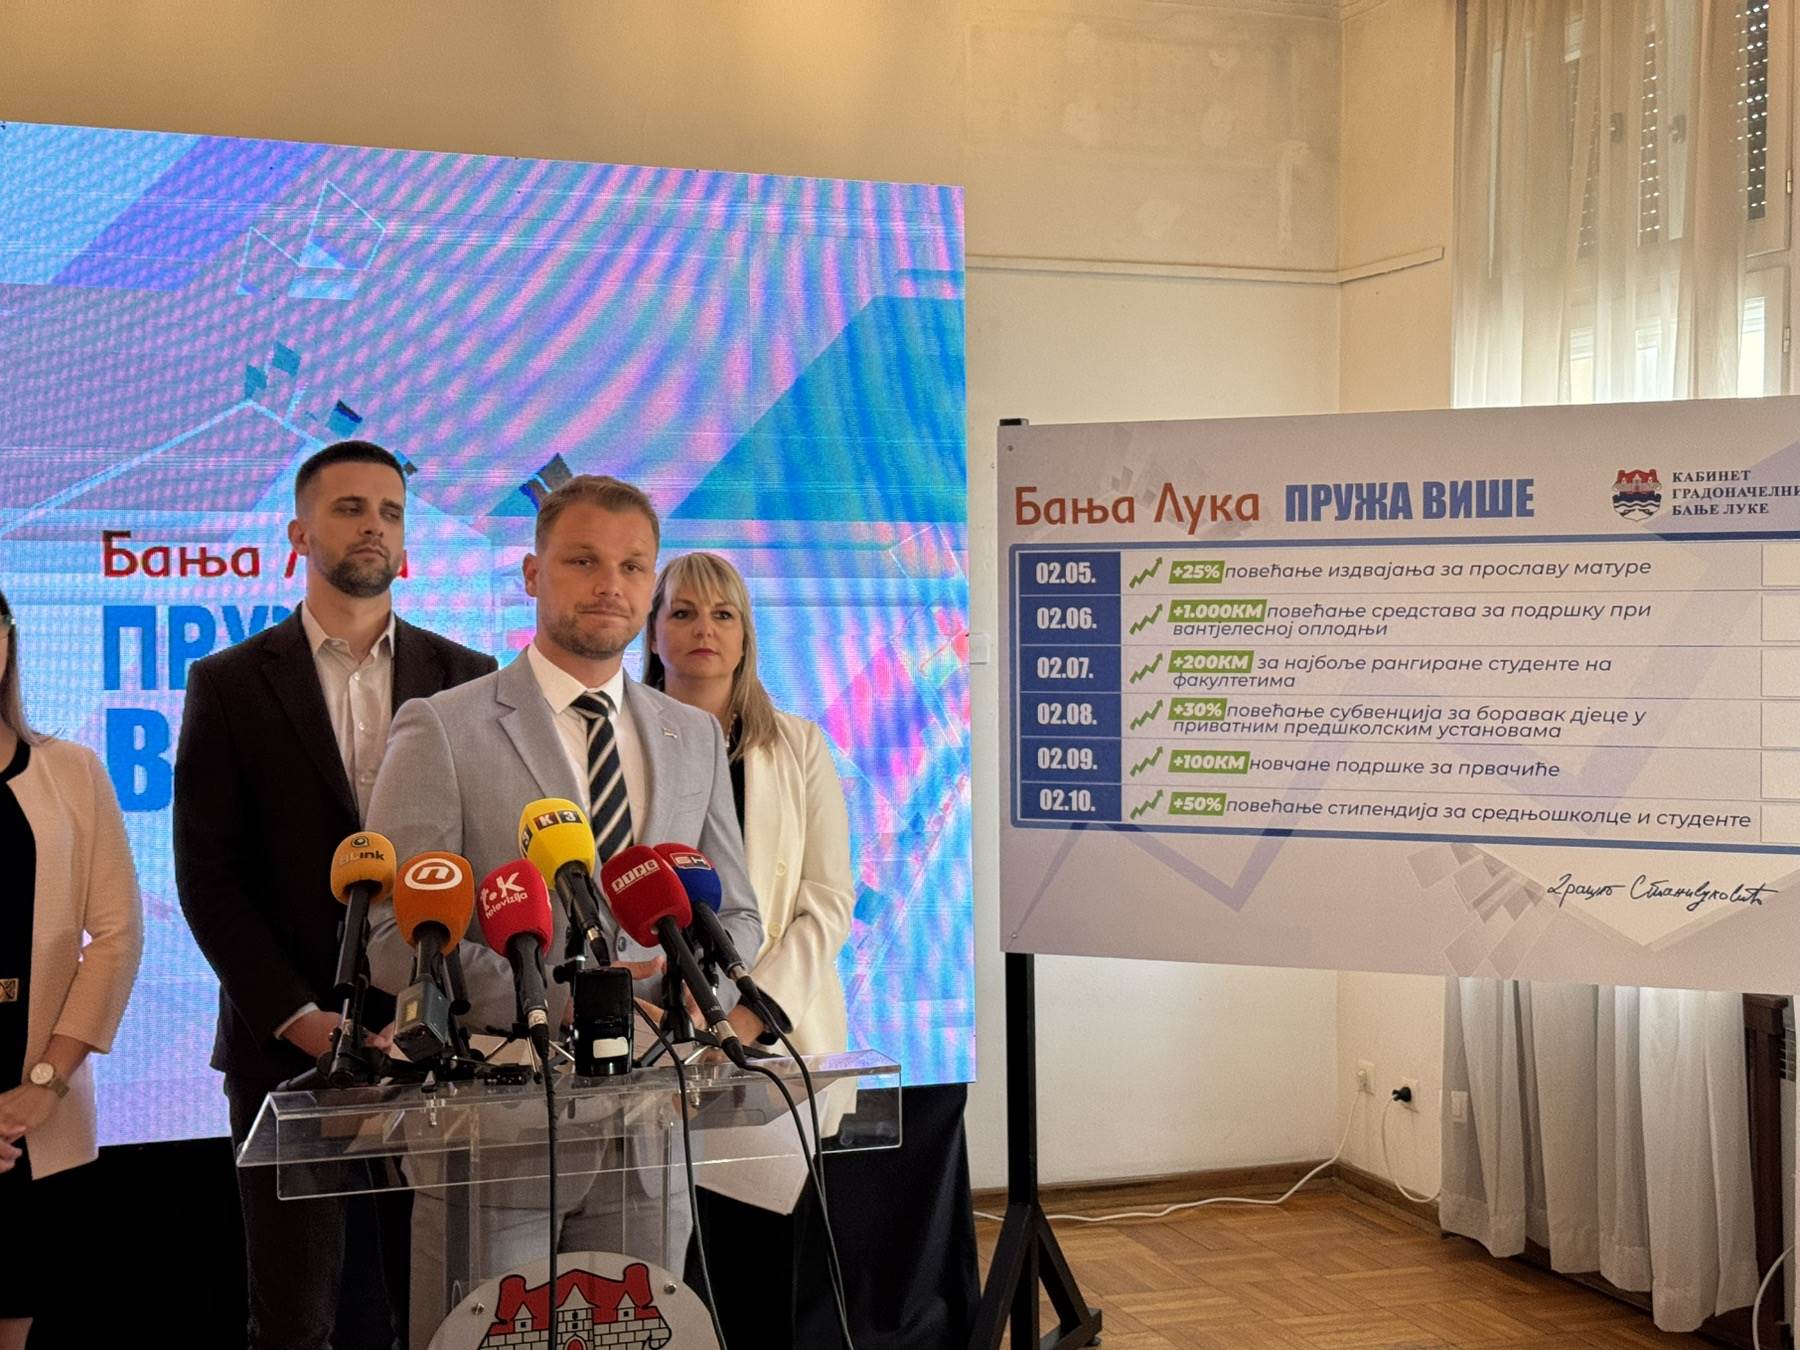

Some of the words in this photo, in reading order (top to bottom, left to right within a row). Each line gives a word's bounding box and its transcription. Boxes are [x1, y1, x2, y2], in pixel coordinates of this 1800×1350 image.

[1672, 470, 1751, 482] КАБИНЕТ
[1015, 486, 1135, 526] Бања
[1154, 482, 1260, 535] Лука
[1285, 481, 1413, 522] ПРУЖА
[1422, 478, 1535, 520] ВИШЕ
[1672, 504, 1719, 516] БАЊЕ
[1723, 503, 1769, 515] ЛУКЕ
[102, 530, 261, 579] Бања
[1035, 561, 1097, 585] 02.05.
[1172, 564, 1220, 579] +25%
[1225, 562, 1322, 579] повећање
[1328, 562, 1435, 582] издвајања
[1440, 564, 1463, 577] за
[1469, 562, 1570, 580] прославу
[1574, 561, 1651, 577] матуре
[1036, 607, 1097, 630] 02.06.
[1173, 604, 1263, 620] +1.000КМ
[1267, 603, 1366, 619] повећање
[1371, 605, 1476, 621] средстава
[1481, 605, 1505, 618] за
[1511, 604, 1605, 620] подршку
[1610, 604, 1651, 619] при
[1173, 622, 1293, 639] вантјелесној
[1298, 622, 1388, 638] оплодњи
[1036, 657, 1094, 679] 02.07.
[1173, 654, 1249, 670] +200КМ
[1257, 657, 1280, 670] за
[1284, 655, 1366, 673] најбоље
[1371, 657, 1483, 673] рангиране
[1488, 658, 1580, 674] студенте
[1585, 658, 1612, 672] на
[1173, 673, 1296, 690] факултетима
[1036, 703, 1097, 726] 02.08.
[1173, 703, 1223, 718] +30%
[1227, 703, 1325, 719] повећање
[1329, 704, 1442, 723] субвенција
[1448, 707, 1471, 721] за
[1477, 705, 1565, 724] боравак
[1571, 707, 1629, 726] дјеце
[1632, 710, 1647, 727] у
[1173, 720, 1279, 735] приватним
[1283, 722, 1432, 738] предшколским
[1436, 724, 1561, 739] установама
[1037, 747, 1098, 770] 02.09.
[1173, 754, 1245, 770] +100КМ
[1250, 758, 1330, 773] новчане
[1335, 760, 1424, 776] подршке
[1430, 762, 1452, 775] за
[1457, 761, 1560, 778] првачиће
[1039, 789, 1096, 812] 02.10.
[1173, 797, 1222, 812] +50%
[1226, 797, 1322, 815] повећање
[1328, 801, 1439, 821] стипендија
[1443, 806, 1466, 819] за
[1471, 807, 1632, 825] средњошколце
[1637, 813, 1650, 825] и
[1656, 813, 1751, 829] студенте
